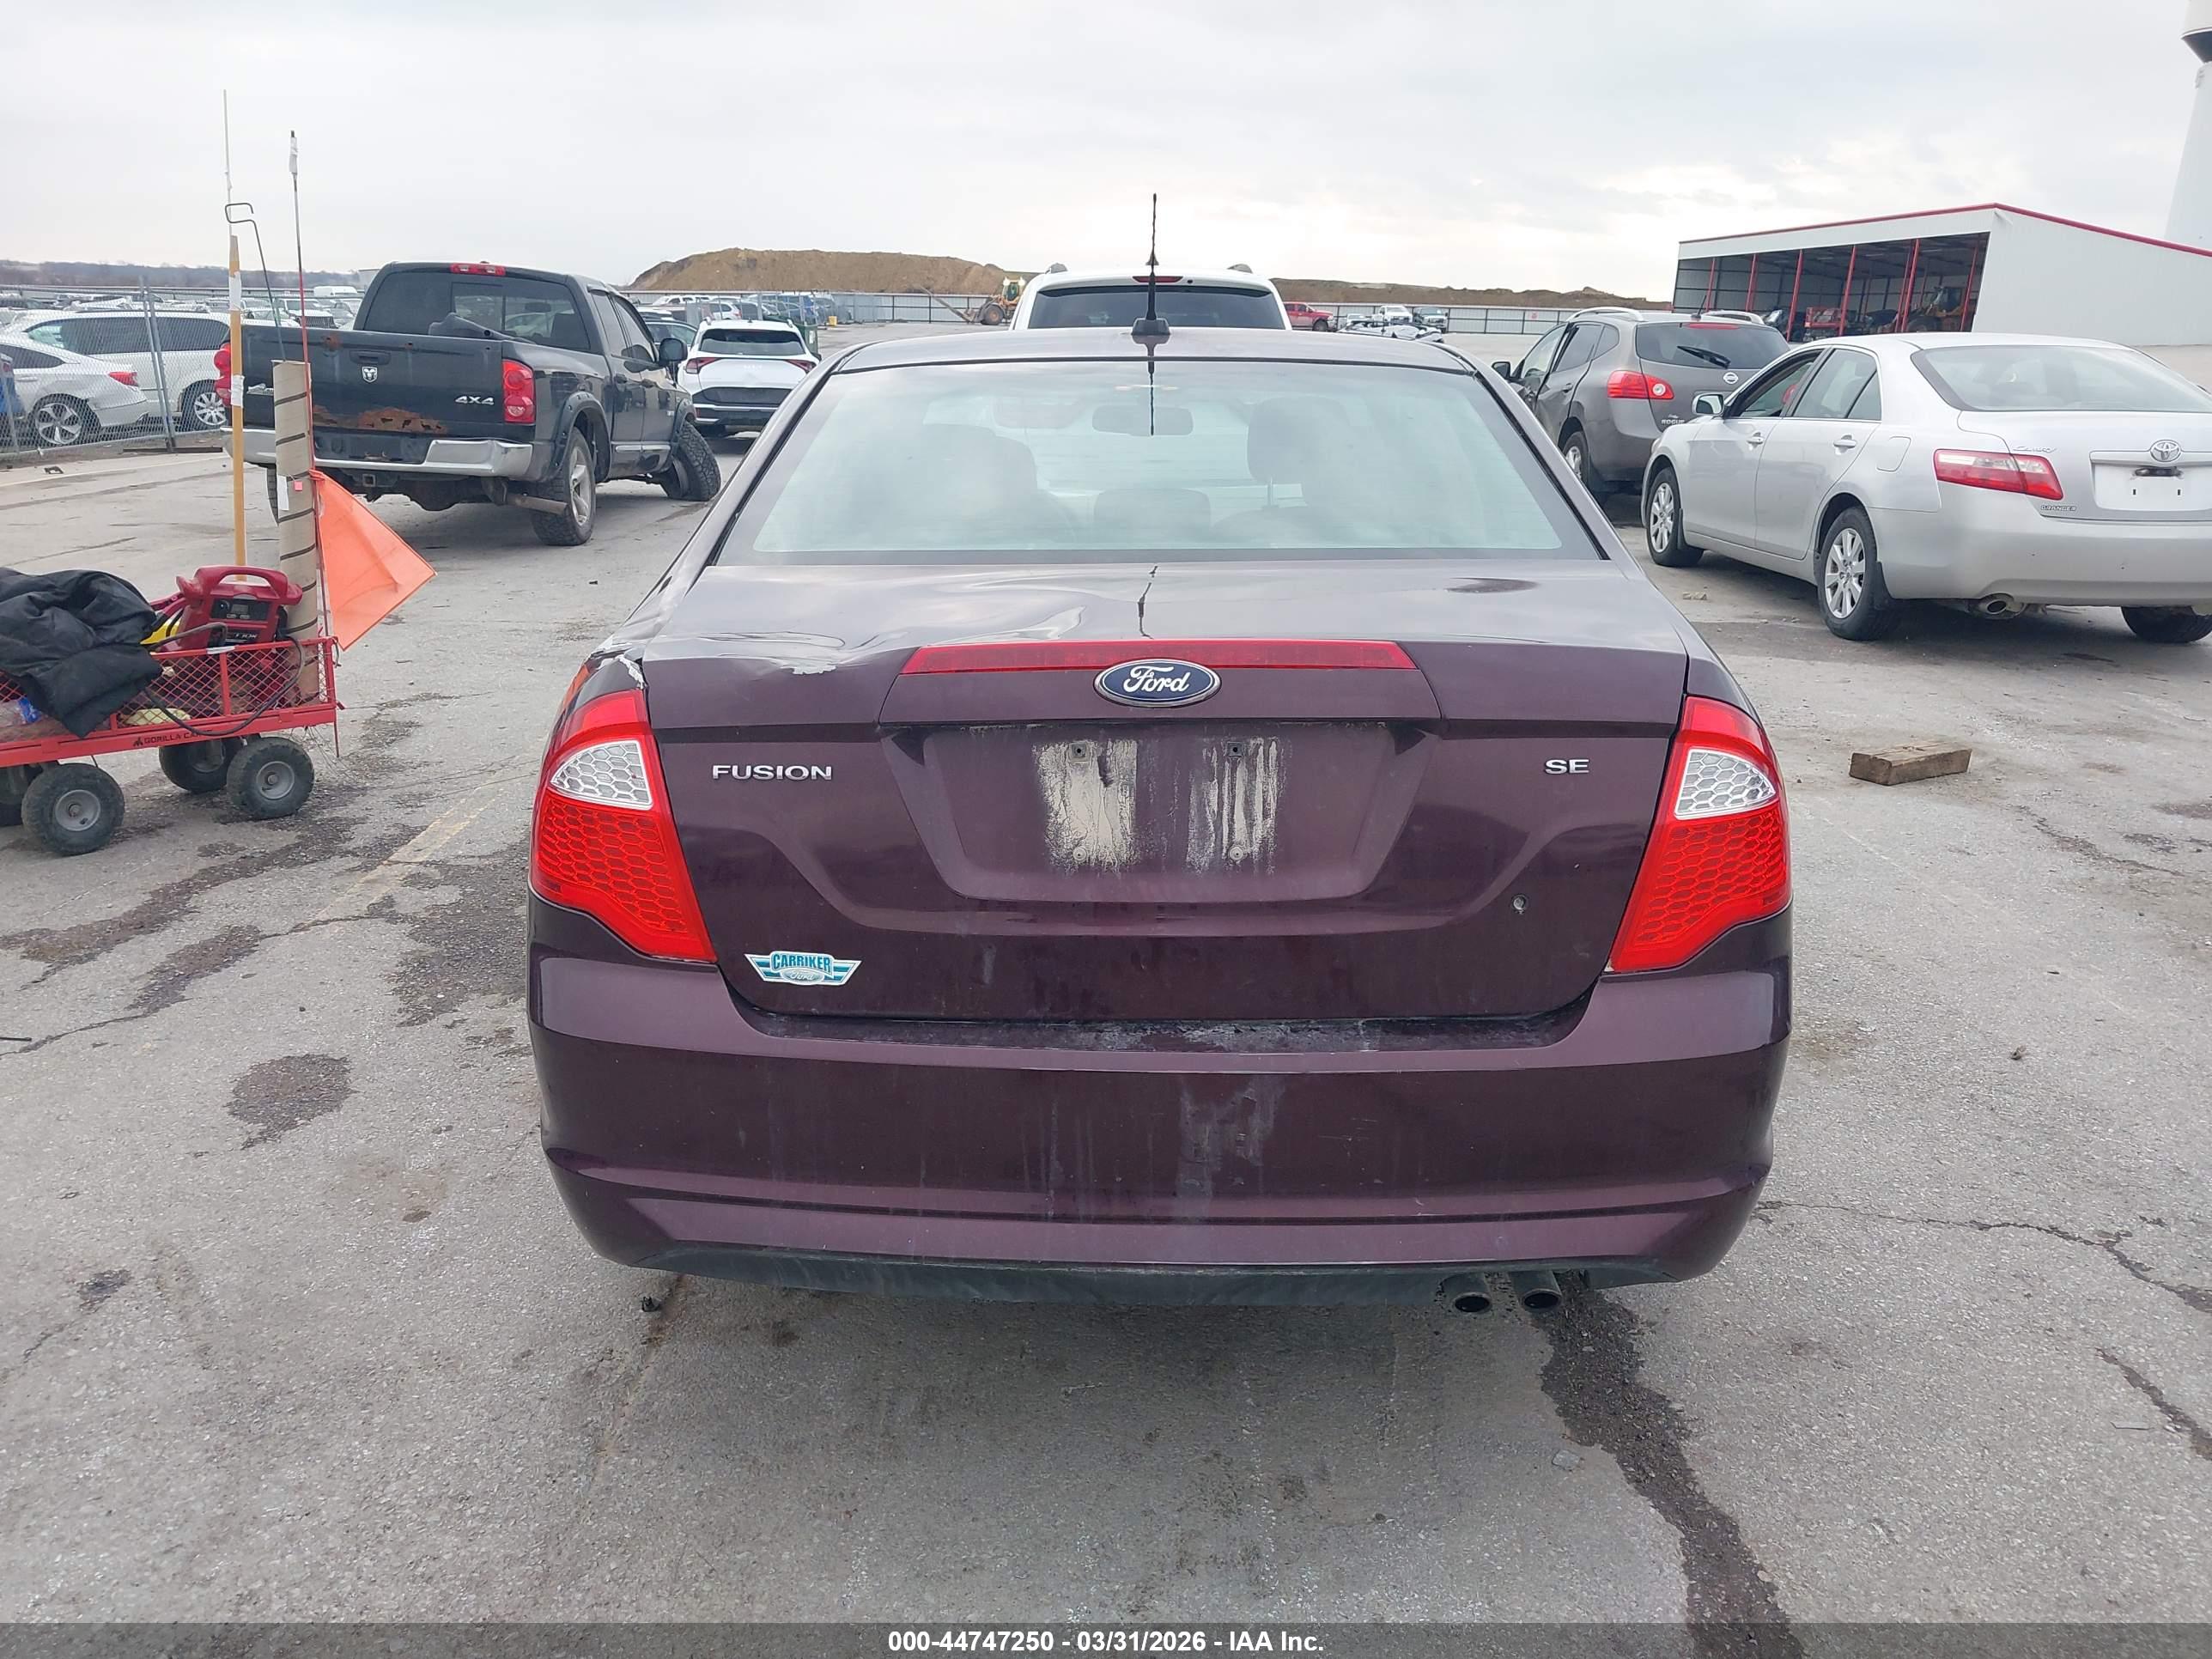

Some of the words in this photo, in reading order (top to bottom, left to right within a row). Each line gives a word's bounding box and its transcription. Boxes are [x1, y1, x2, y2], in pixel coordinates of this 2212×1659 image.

[1122, 665, 1191, 693] Ford
[143, 733, 181, 744] GORILLA
[712, 764, 832, 781] FUSION
[1545, 758, 1589, 775] SE
[773, 953, 832, 974] CARRIKER
[788, 969, 814, 981] Ford
